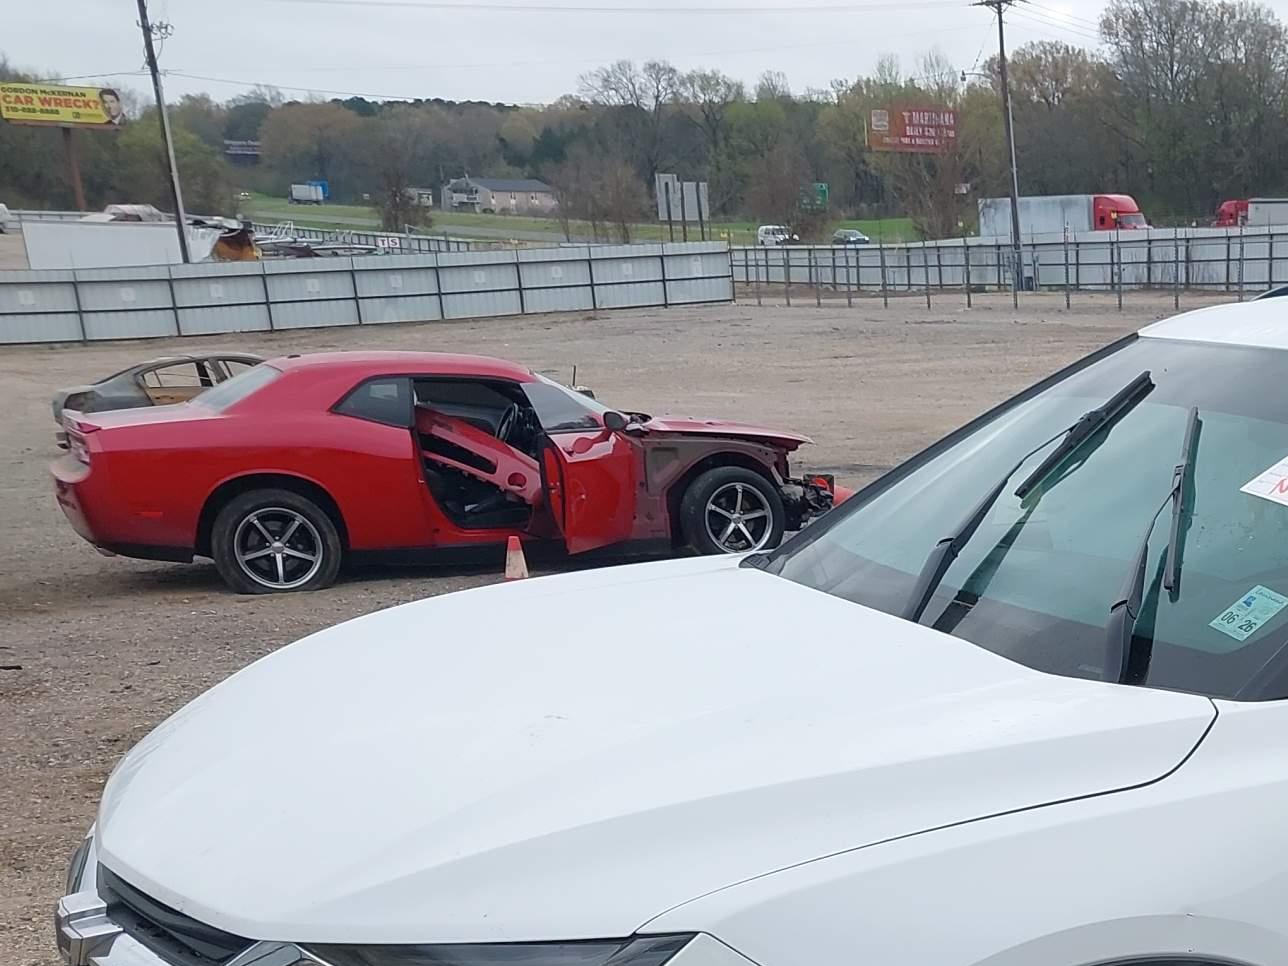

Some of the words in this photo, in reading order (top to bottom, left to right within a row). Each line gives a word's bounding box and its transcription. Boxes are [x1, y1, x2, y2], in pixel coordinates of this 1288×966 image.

[1, 87, 38, 95] GORDON
[2, 95, 34, 106] CAR
[38, 96, 100, 109] WRECK?
[1221, 611, 1239, 624] 06
[1238, 619, 1257, 632] 26
